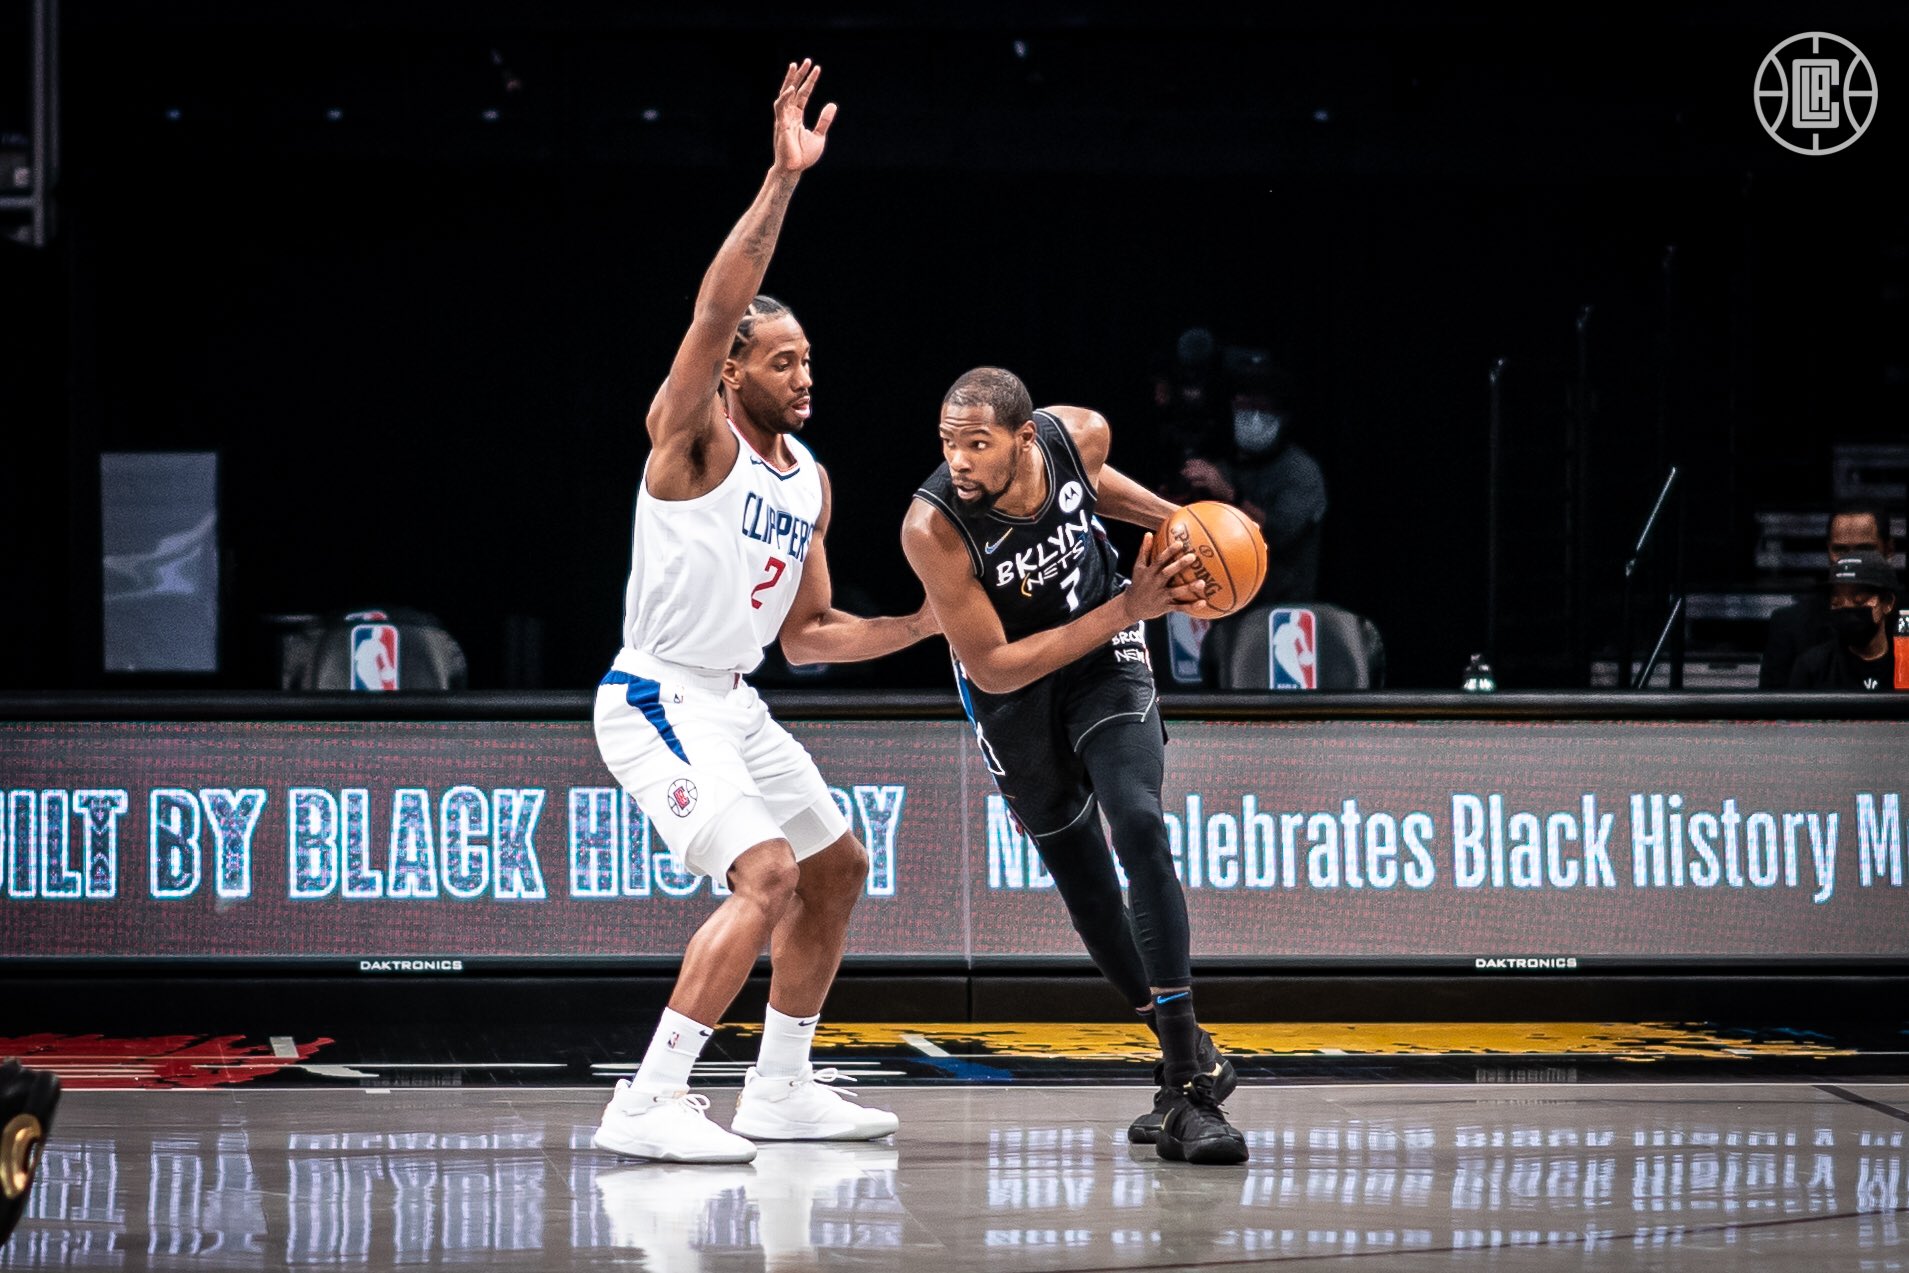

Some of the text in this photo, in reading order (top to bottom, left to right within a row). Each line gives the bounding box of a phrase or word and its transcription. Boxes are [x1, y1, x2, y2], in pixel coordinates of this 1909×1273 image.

[996, 509, 1089, 587] BKLYN
[1026, 540, 1085, 591] NETS
[751, 556, 786, 609] 2
[1059, 567, 1081, 612] 7
[0, 788, 128, 898] ILT
[150, 788, 266, 898] BY
[289, 786, 546, 898] BLACK
[1113, 795, 1436, 888] elebrates
[1453, 794, 1617, 888] Black
[1631, 794, 1838, 904] History
[1856, 794, 1909, 887] M
[360, 960, 463, 970] DAKTRONICS
[1475, 958, 1577, 968] DAKTRONICS
